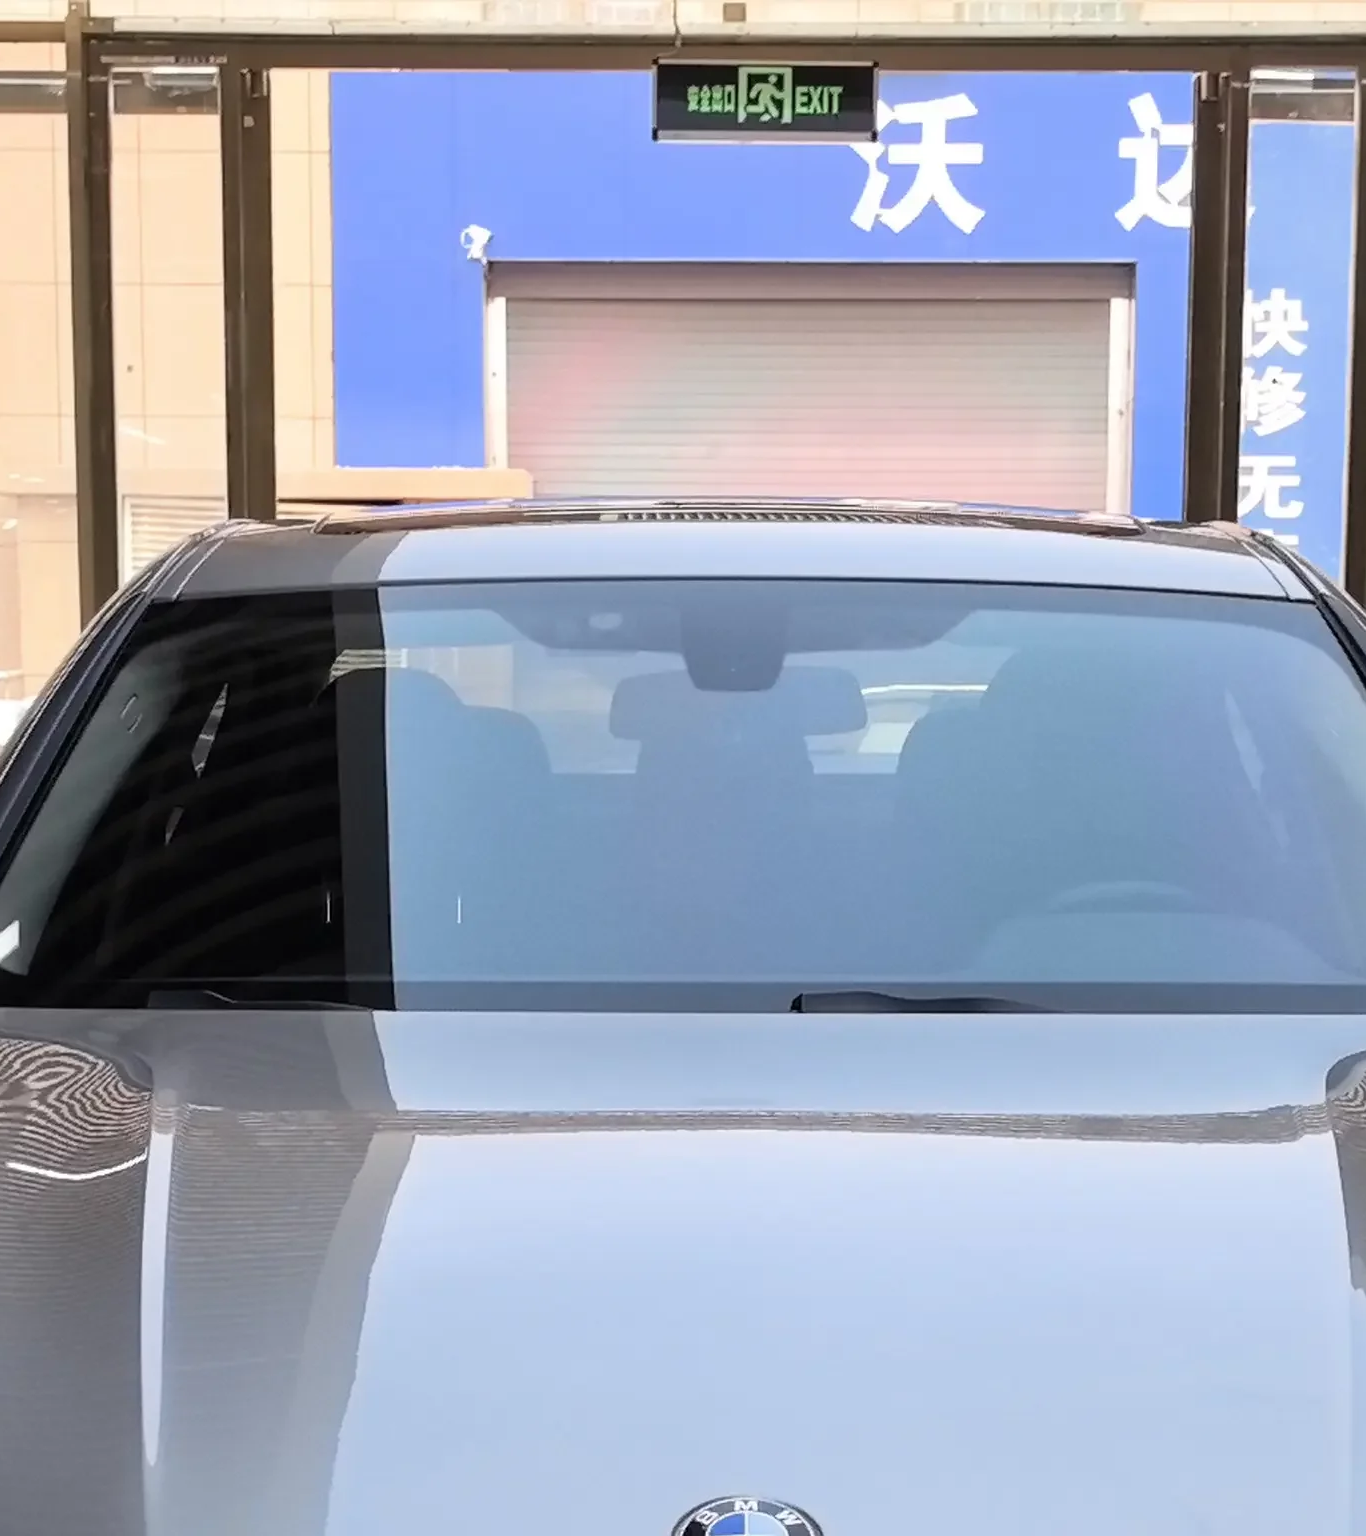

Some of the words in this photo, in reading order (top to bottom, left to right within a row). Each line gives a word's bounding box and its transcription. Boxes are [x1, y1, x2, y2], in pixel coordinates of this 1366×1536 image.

[795, 86, 843, 115] EXIT
[1237, 287, 1309, 546] 快修无
[695, 1499, 802, 1527] BMW
